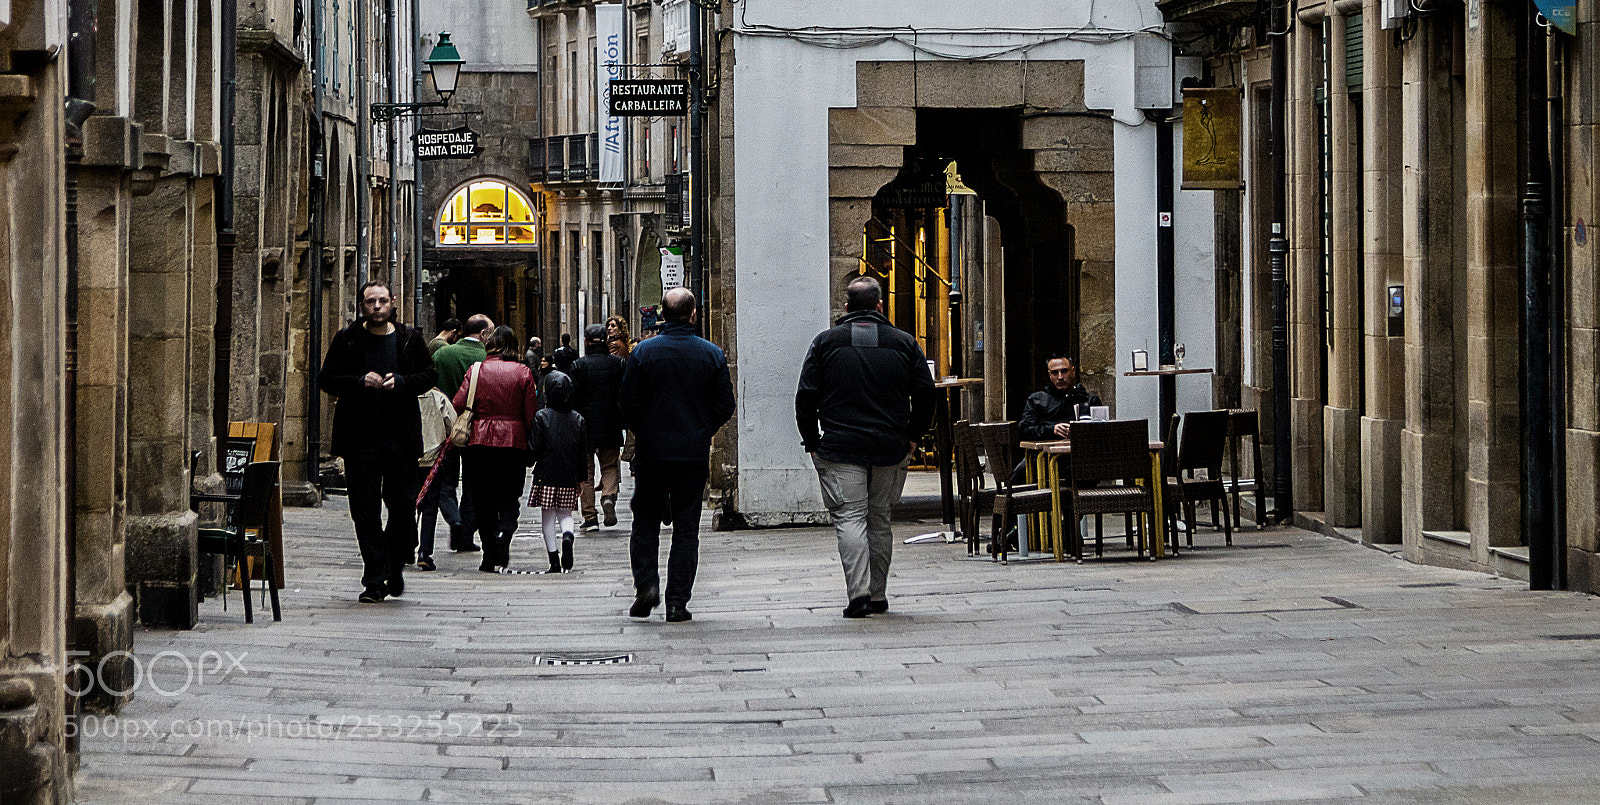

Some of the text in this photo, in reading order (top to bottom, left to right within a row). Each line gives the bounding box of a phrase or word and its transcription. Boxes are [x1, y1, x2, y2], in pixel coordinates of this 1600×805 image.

[612, 84, 684, 95] RESTAURANTE
[614, 100, 682, 111] CARBALLEIRA
[417, 132, 473, 145] HOSPEDAJE
[418, 144, 475, 157] SANTA CRUZ
